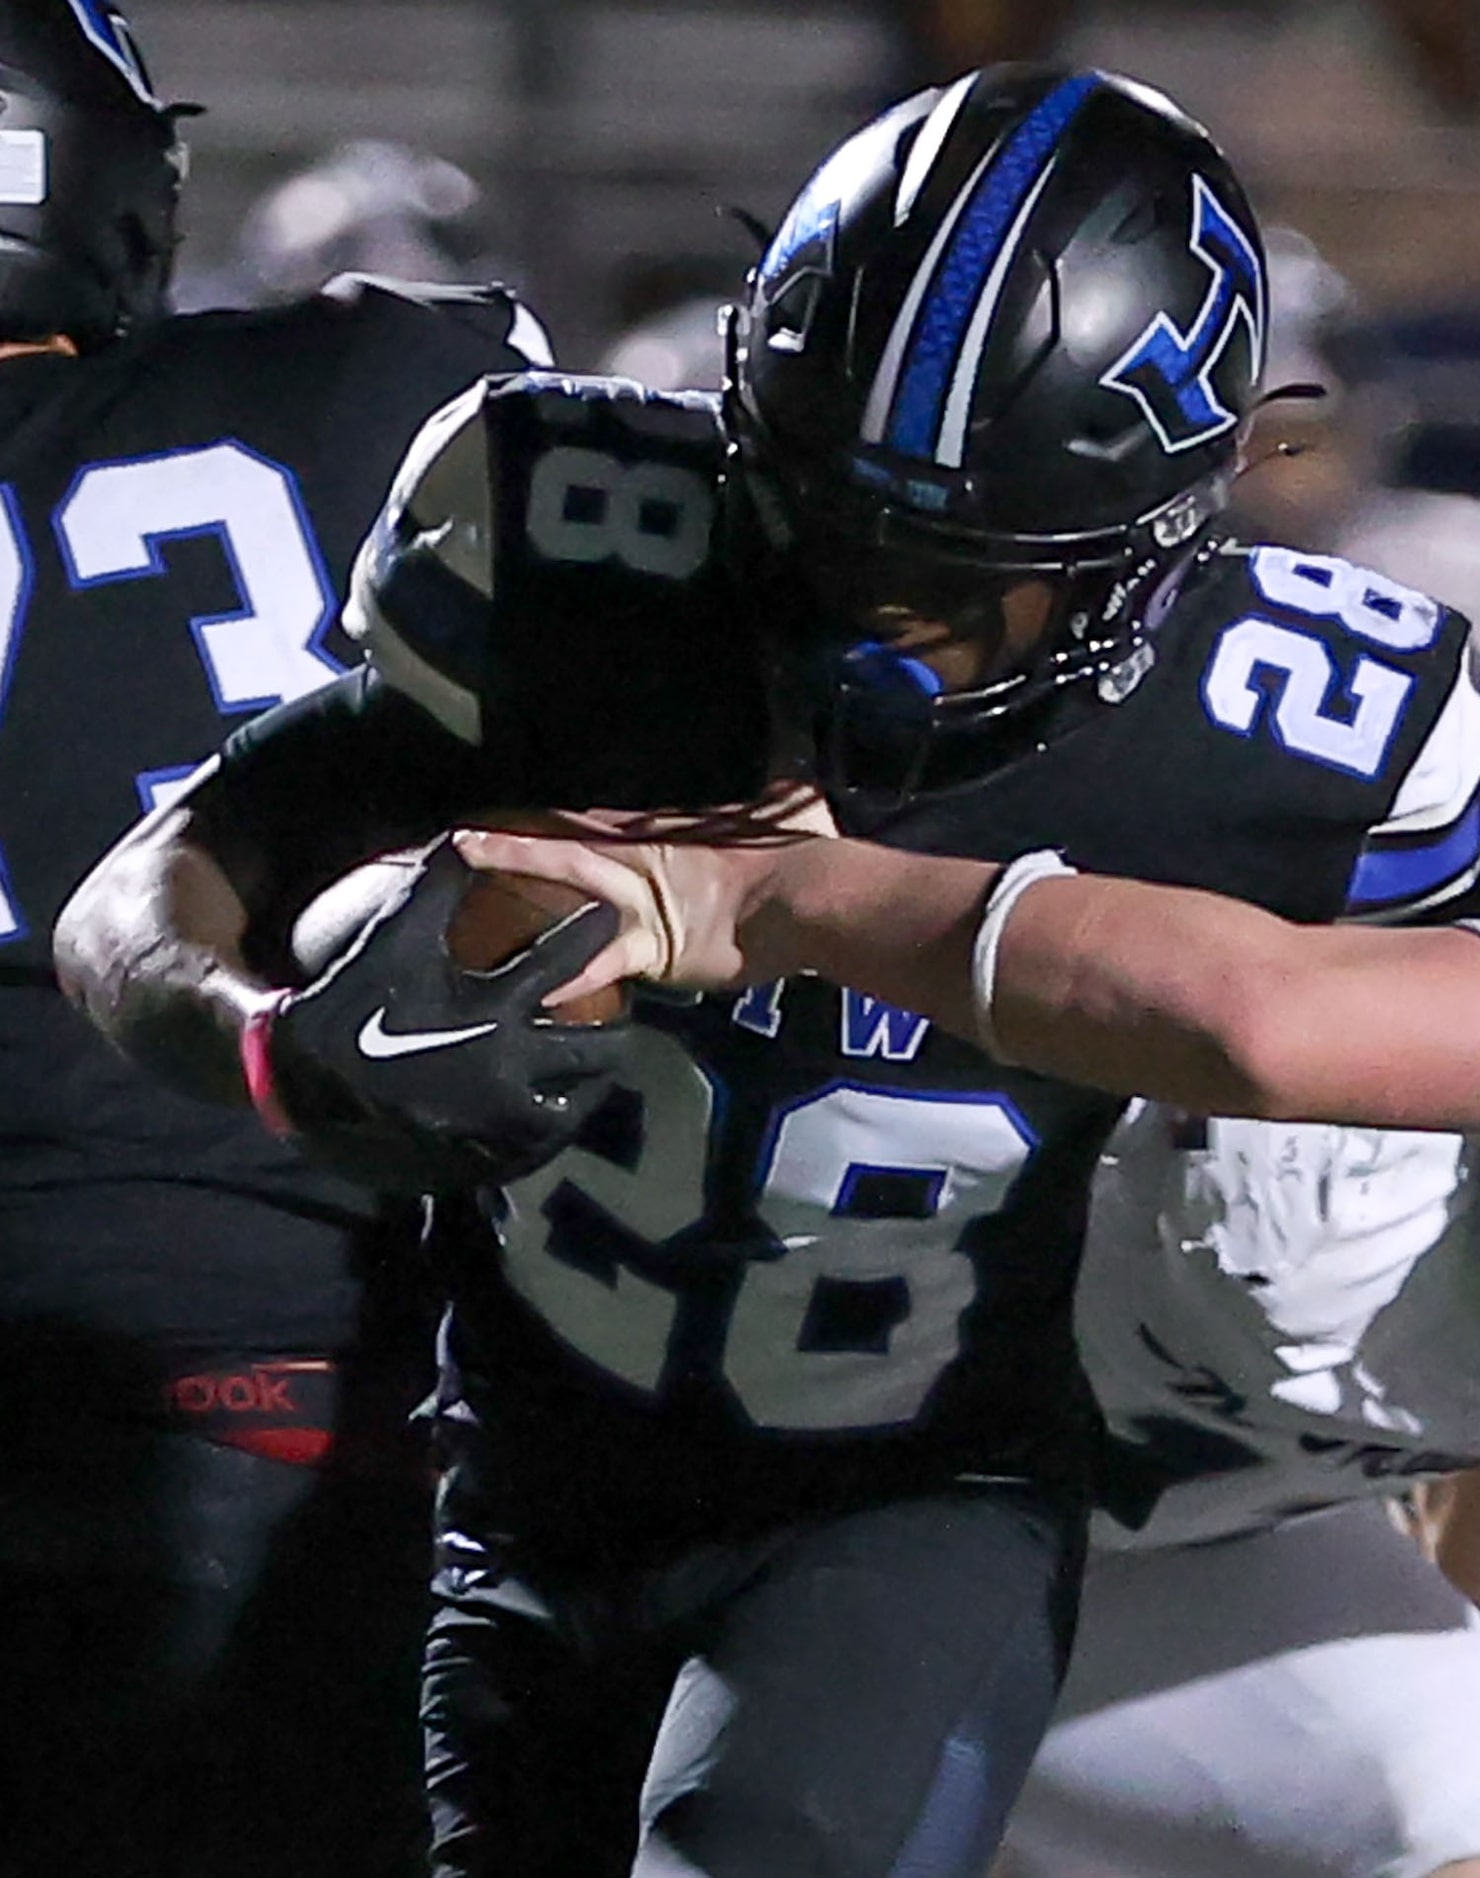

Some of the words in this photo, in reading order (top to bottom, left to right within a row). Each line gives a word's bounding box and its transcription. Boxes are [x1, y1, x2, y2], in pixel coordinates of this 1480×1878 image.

[527, 398, 718, 581] 8
[0, 436, 350, 942] 3
[1200, 541, 1438, 784] 28
[500, 1015, 1042, 1432] 28
